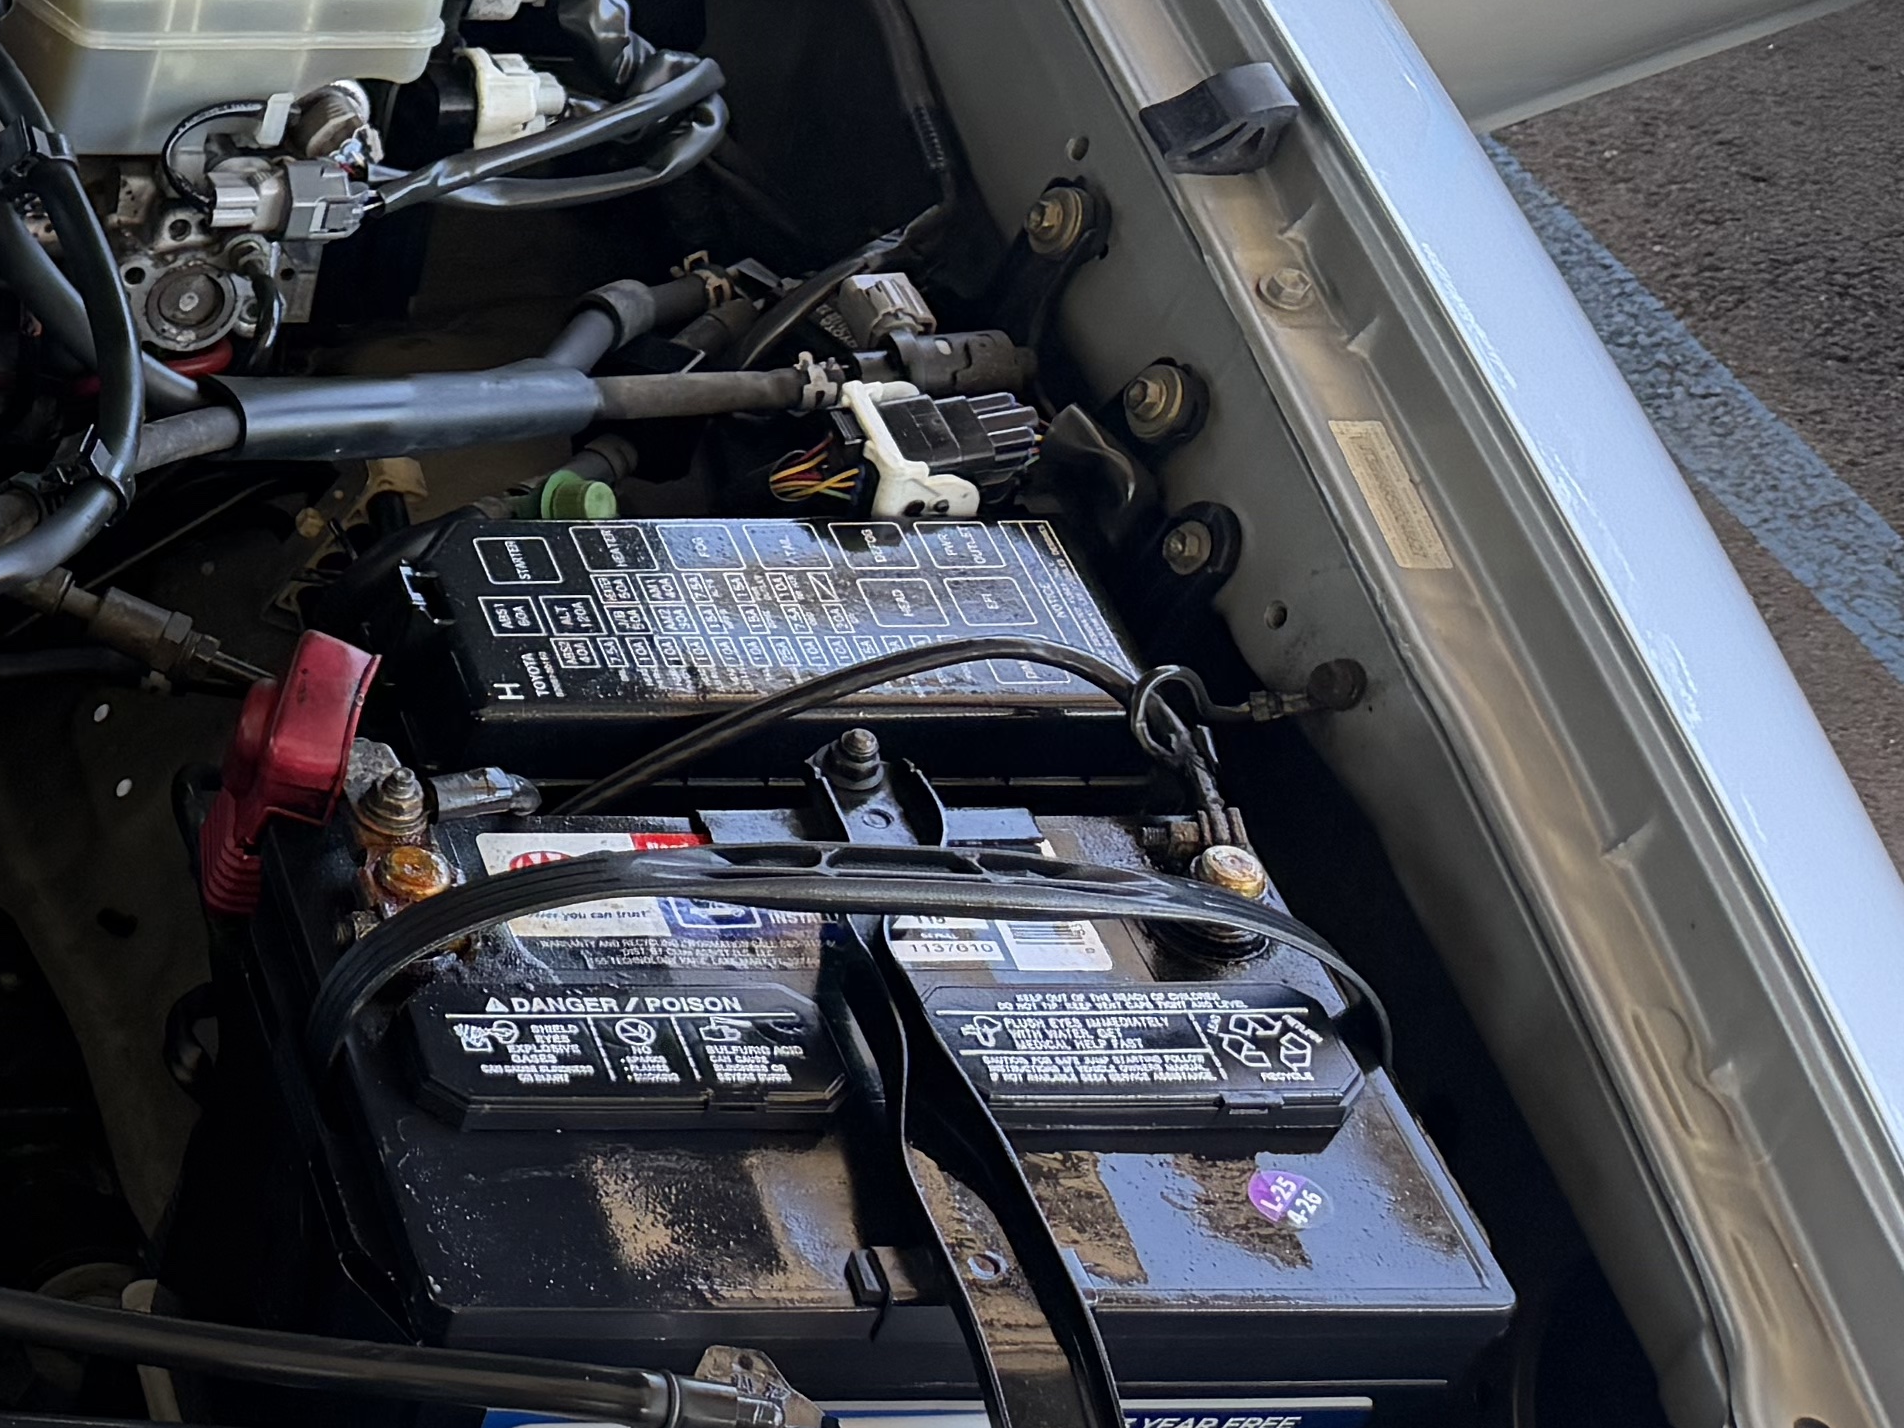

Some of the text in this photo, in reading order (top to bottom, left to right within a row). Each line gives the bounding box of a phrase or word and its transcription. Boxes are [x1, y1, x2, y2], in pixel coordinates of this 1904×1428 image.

[601, 529, 628, 568] HEATER
[692, 536, 710, 558] FOG
[861, 529, 887, 563] DEFOG
[505, 540, 531, 580] STARTER
[554, 605, 574, 626] ALT
[572, 602, 591, 628] 120A
[521, 653, 550, 698] TOYOTA
[493, 683, 524, 700] H
[561, 910, 587, 922] you
[590, 910, 613, 920] can
[1045, 994, 1068, 1002] OUT
[512, 996, 742, 1013] DANGER / POISON
[530, 1024, 579, 1034] SHIELD
[1004, 1017, 1169, 1029] FLUSH EYES IMMEDIATELY
[535, 1034, 571, 1043] EYES
[1010, 1029, 1044, 1040] WITH
[507, 1044, 581, 1054] EXPLOSIVE
[774, 1045, 804, 1055] ACID
[1014, 1038, 1144, 1050] MEDICAL HELP FAST
[632, 1046, 652, 1055] NO
[1259, 1071, 1315, 1082] RECYCLE
